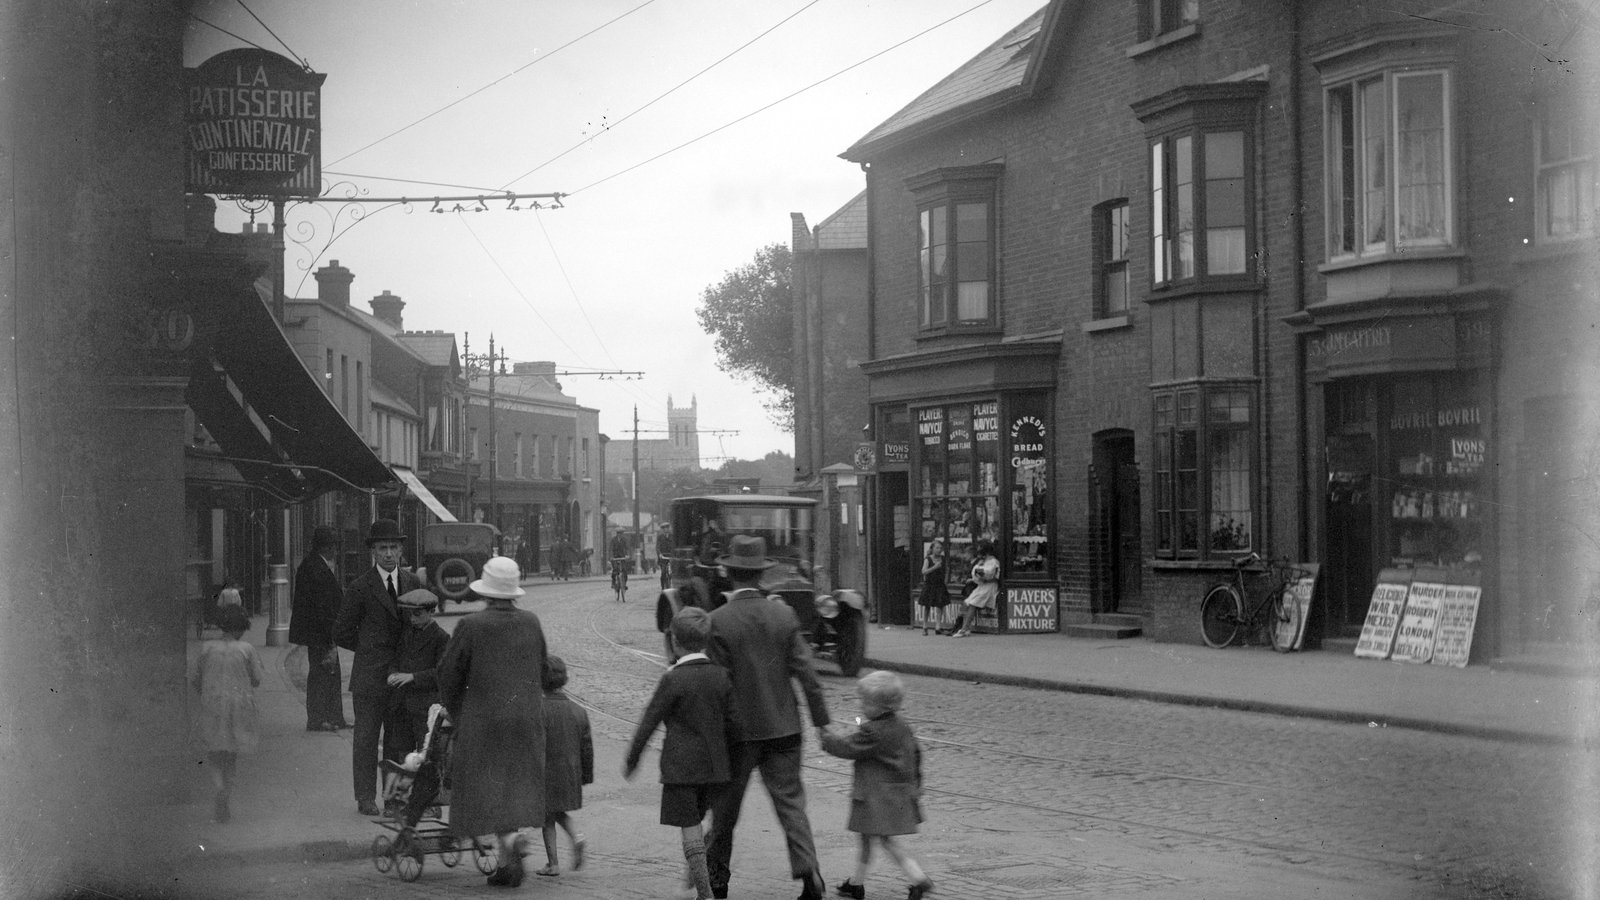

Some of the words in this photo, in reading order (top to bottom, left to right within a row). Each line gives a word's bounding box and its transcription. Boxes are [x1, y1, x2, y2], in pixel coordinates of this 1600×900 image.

[236, 65, 269, 88] LA
[189, 87, 316, 119] PATISSERIE
[190, 119, 315, 156] CONTINENTALE
[210, 151, 296, 172] CONFESSERIE
[1438, 408, 1481, 427] BOVRIL
[1010, 415, 1046, 438] KENNEDYS
[1014, 443, 1044, 452] BREAD
[895, 452, 909, 460] TEA
[1467, 453, 1485, 464] TEA
[1411, 586, 1445, 600] MURDER
[1013, 604, 1051, 617] NAVY
[1369, 601, 1391, 615] WAR
[1404, 606, 1439, 619] ROBBERY
[1008, 618, 1057, 631] MIXTURE
[1365, 614, 1396, 628] MEXICO
[1399, 626, 1434, 640] LONDON
